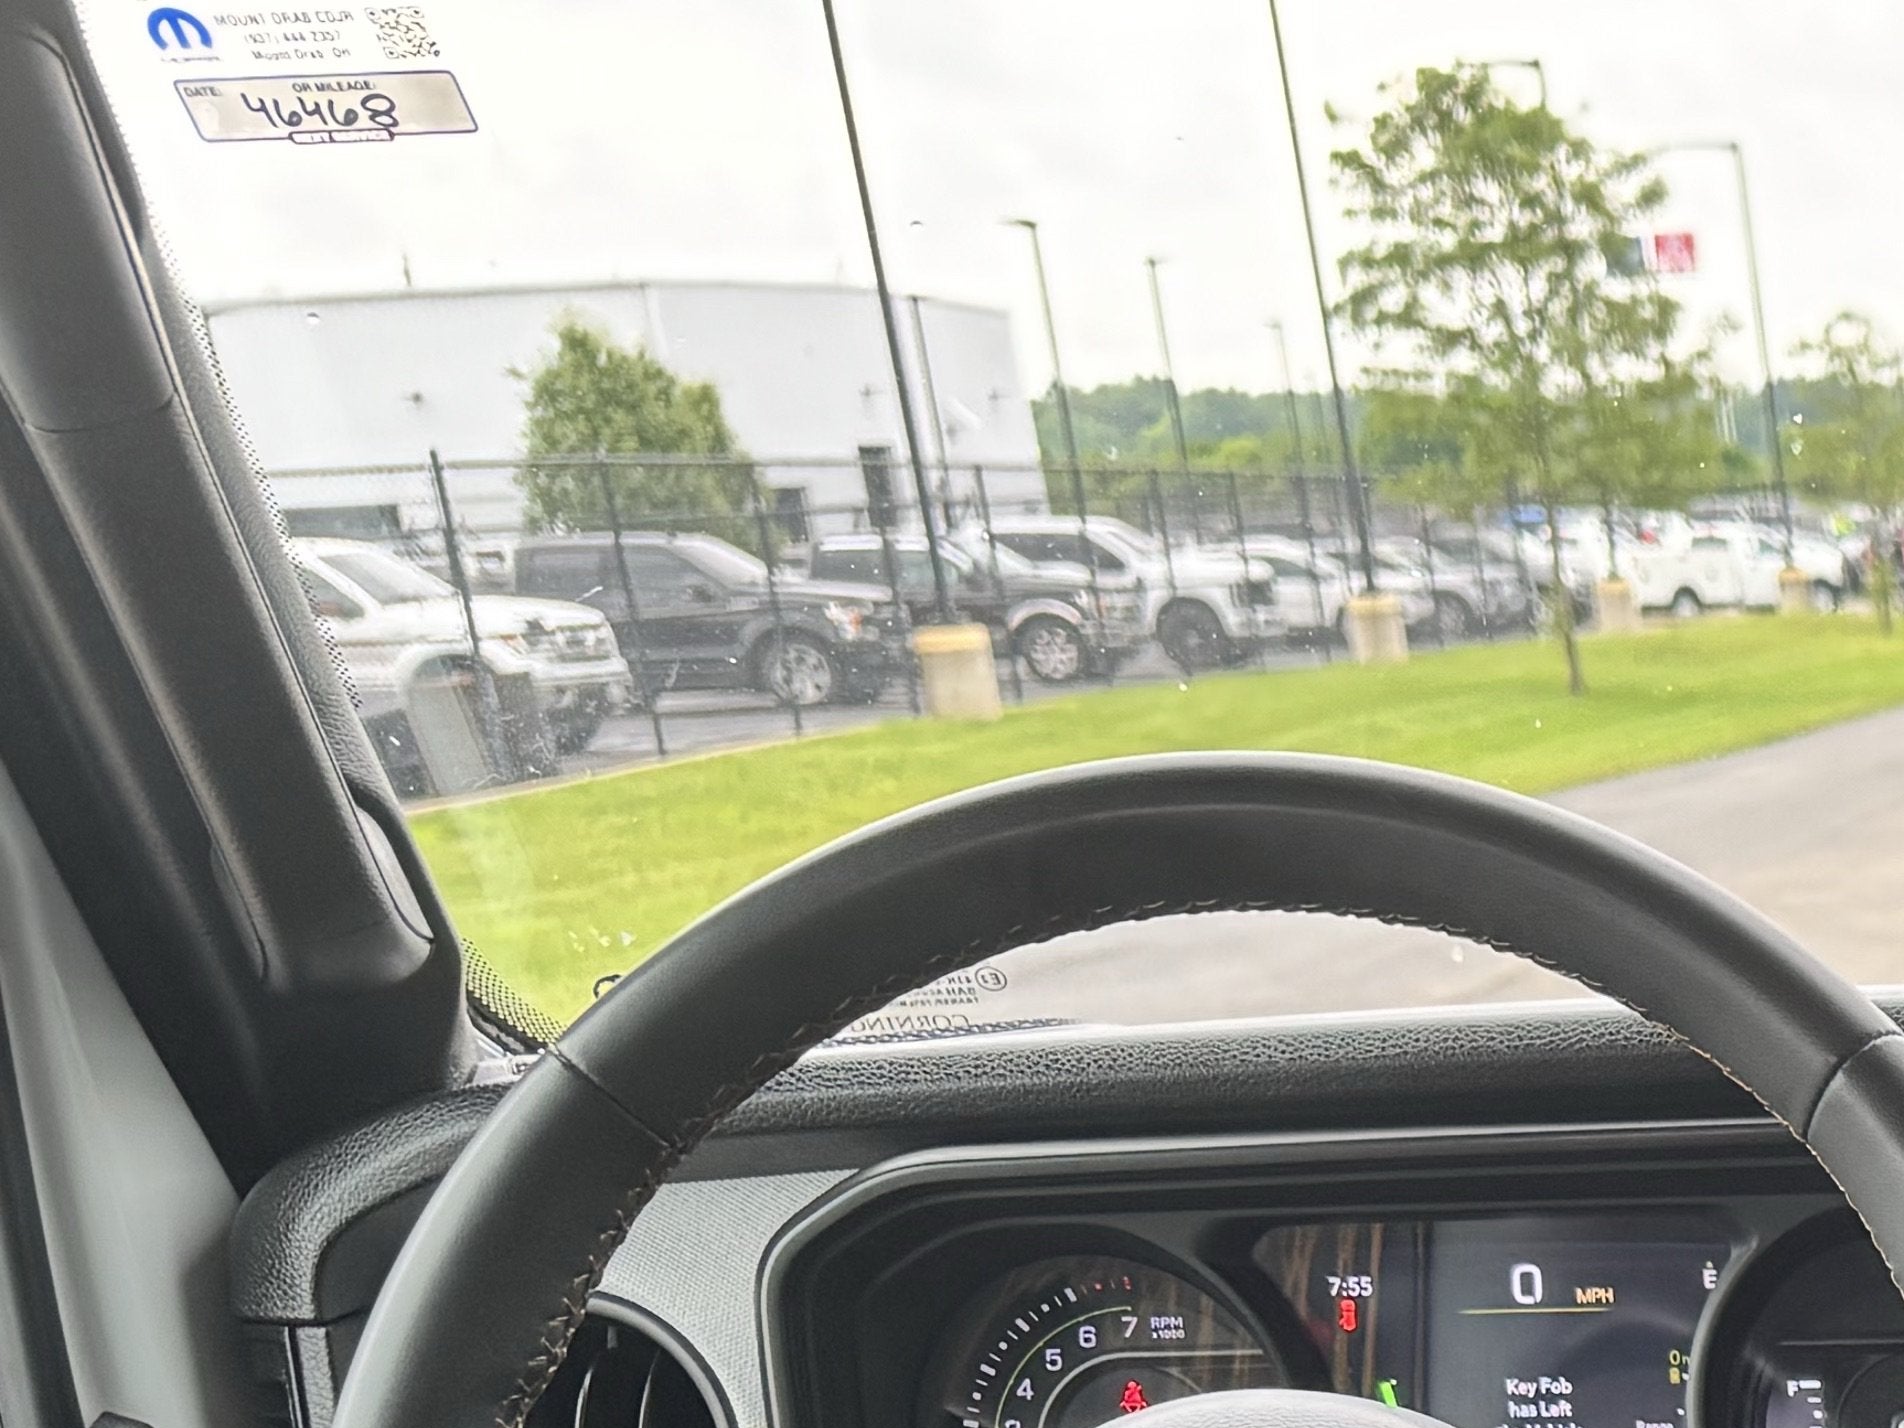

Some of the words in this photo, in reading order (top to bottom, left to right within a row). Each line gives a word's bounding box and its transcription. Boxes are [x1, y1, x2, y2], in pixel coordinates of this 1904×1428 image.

[240, 92, 400, 129] 46468
[1328, 1276, 1373, 1298] 7:55
[1510, 1264, 1543, 1306] 0
[1576, 1287, 1615, 1305] MPH
[1121, 1316, 1139, 1338] 7
[1150, 1316, 1184, 1330] RPM
[1078, 1325, 1097, 1348] 6
[1044, 1349, 1063, 1371] 5
[1016, 1378, 1035, 1400] 4
[1506, 1378, 1538, 1398] Key
[1539, 1376, 1573, 1396] Fob
[1508, 1401, 1538, 1418] has
[1539, 1399, 1573, 1418] Left
